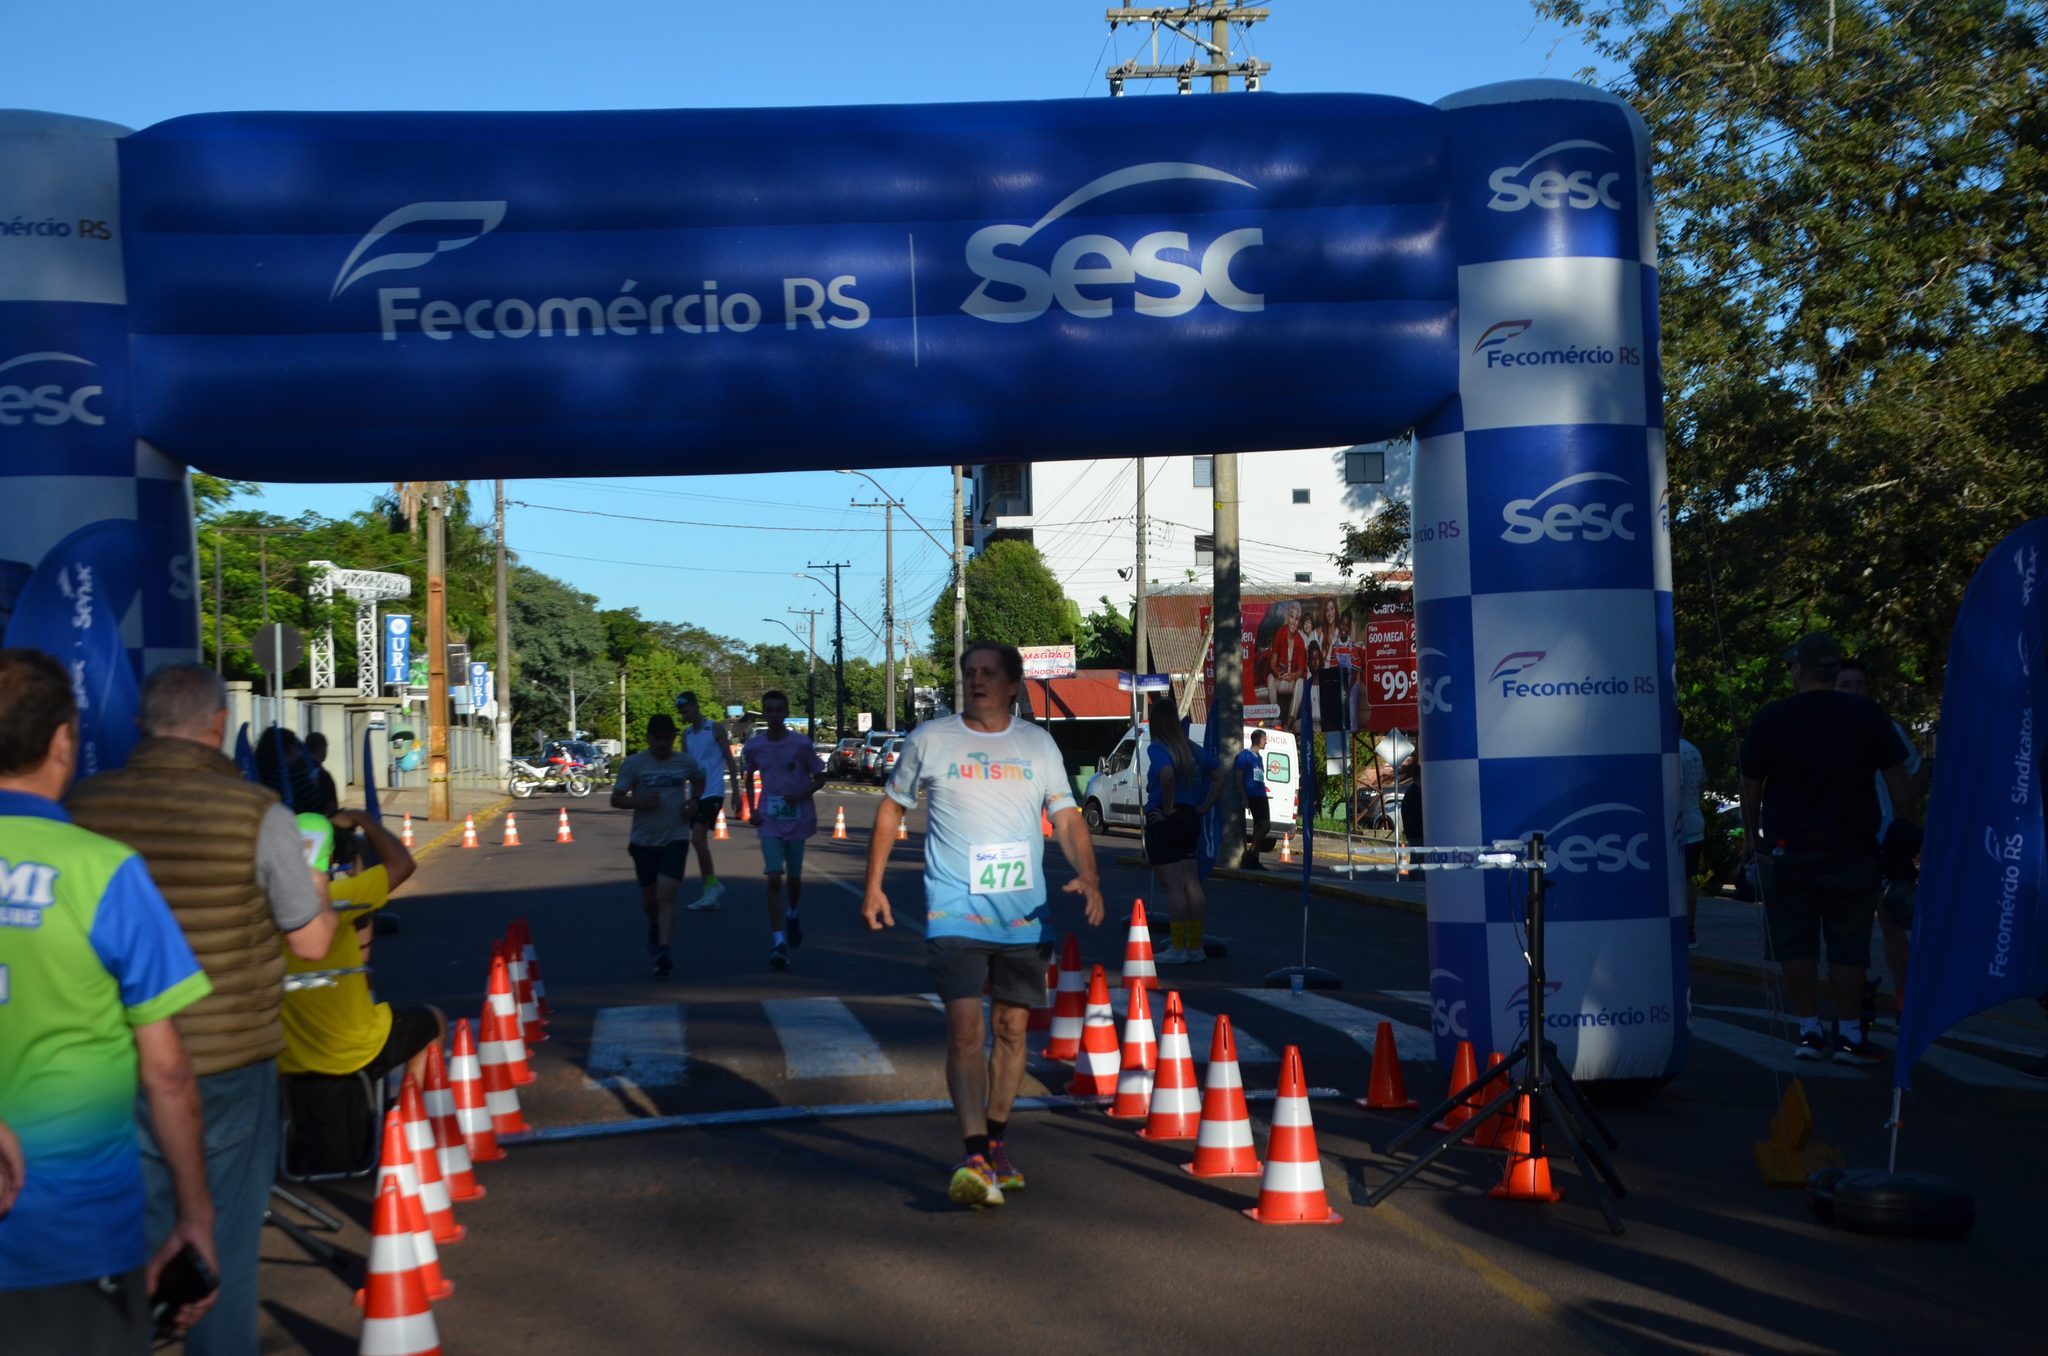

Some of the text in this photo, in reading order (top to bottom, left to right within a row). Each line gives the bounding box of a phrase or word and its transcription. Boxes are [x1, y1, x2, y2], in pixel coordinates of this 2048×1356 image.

[78, 219, 113, 241] RS
[378, 275, 871, 341] Fecomércio RS
[1487, 345, 1641, 369] Fecomércio RS
[1438, 519, 1460, 540] RS
[1368, 631, 1404, 644] 600 MEGA
[391, 637, 406, 681] URI
[473, 677, 484, 707] URI
[1502, 675, 1656, 699] Fecomércio RS
[2010, 706, 2034, 806] Sindicatos
[946, 761, 1034, 782] Autismo
[979, 860, 1028, 889] 472
[1987, 832, 2024, 979] Fecomércio RS
[1518, 1004, 1671, 1029] Fcomércio RS
